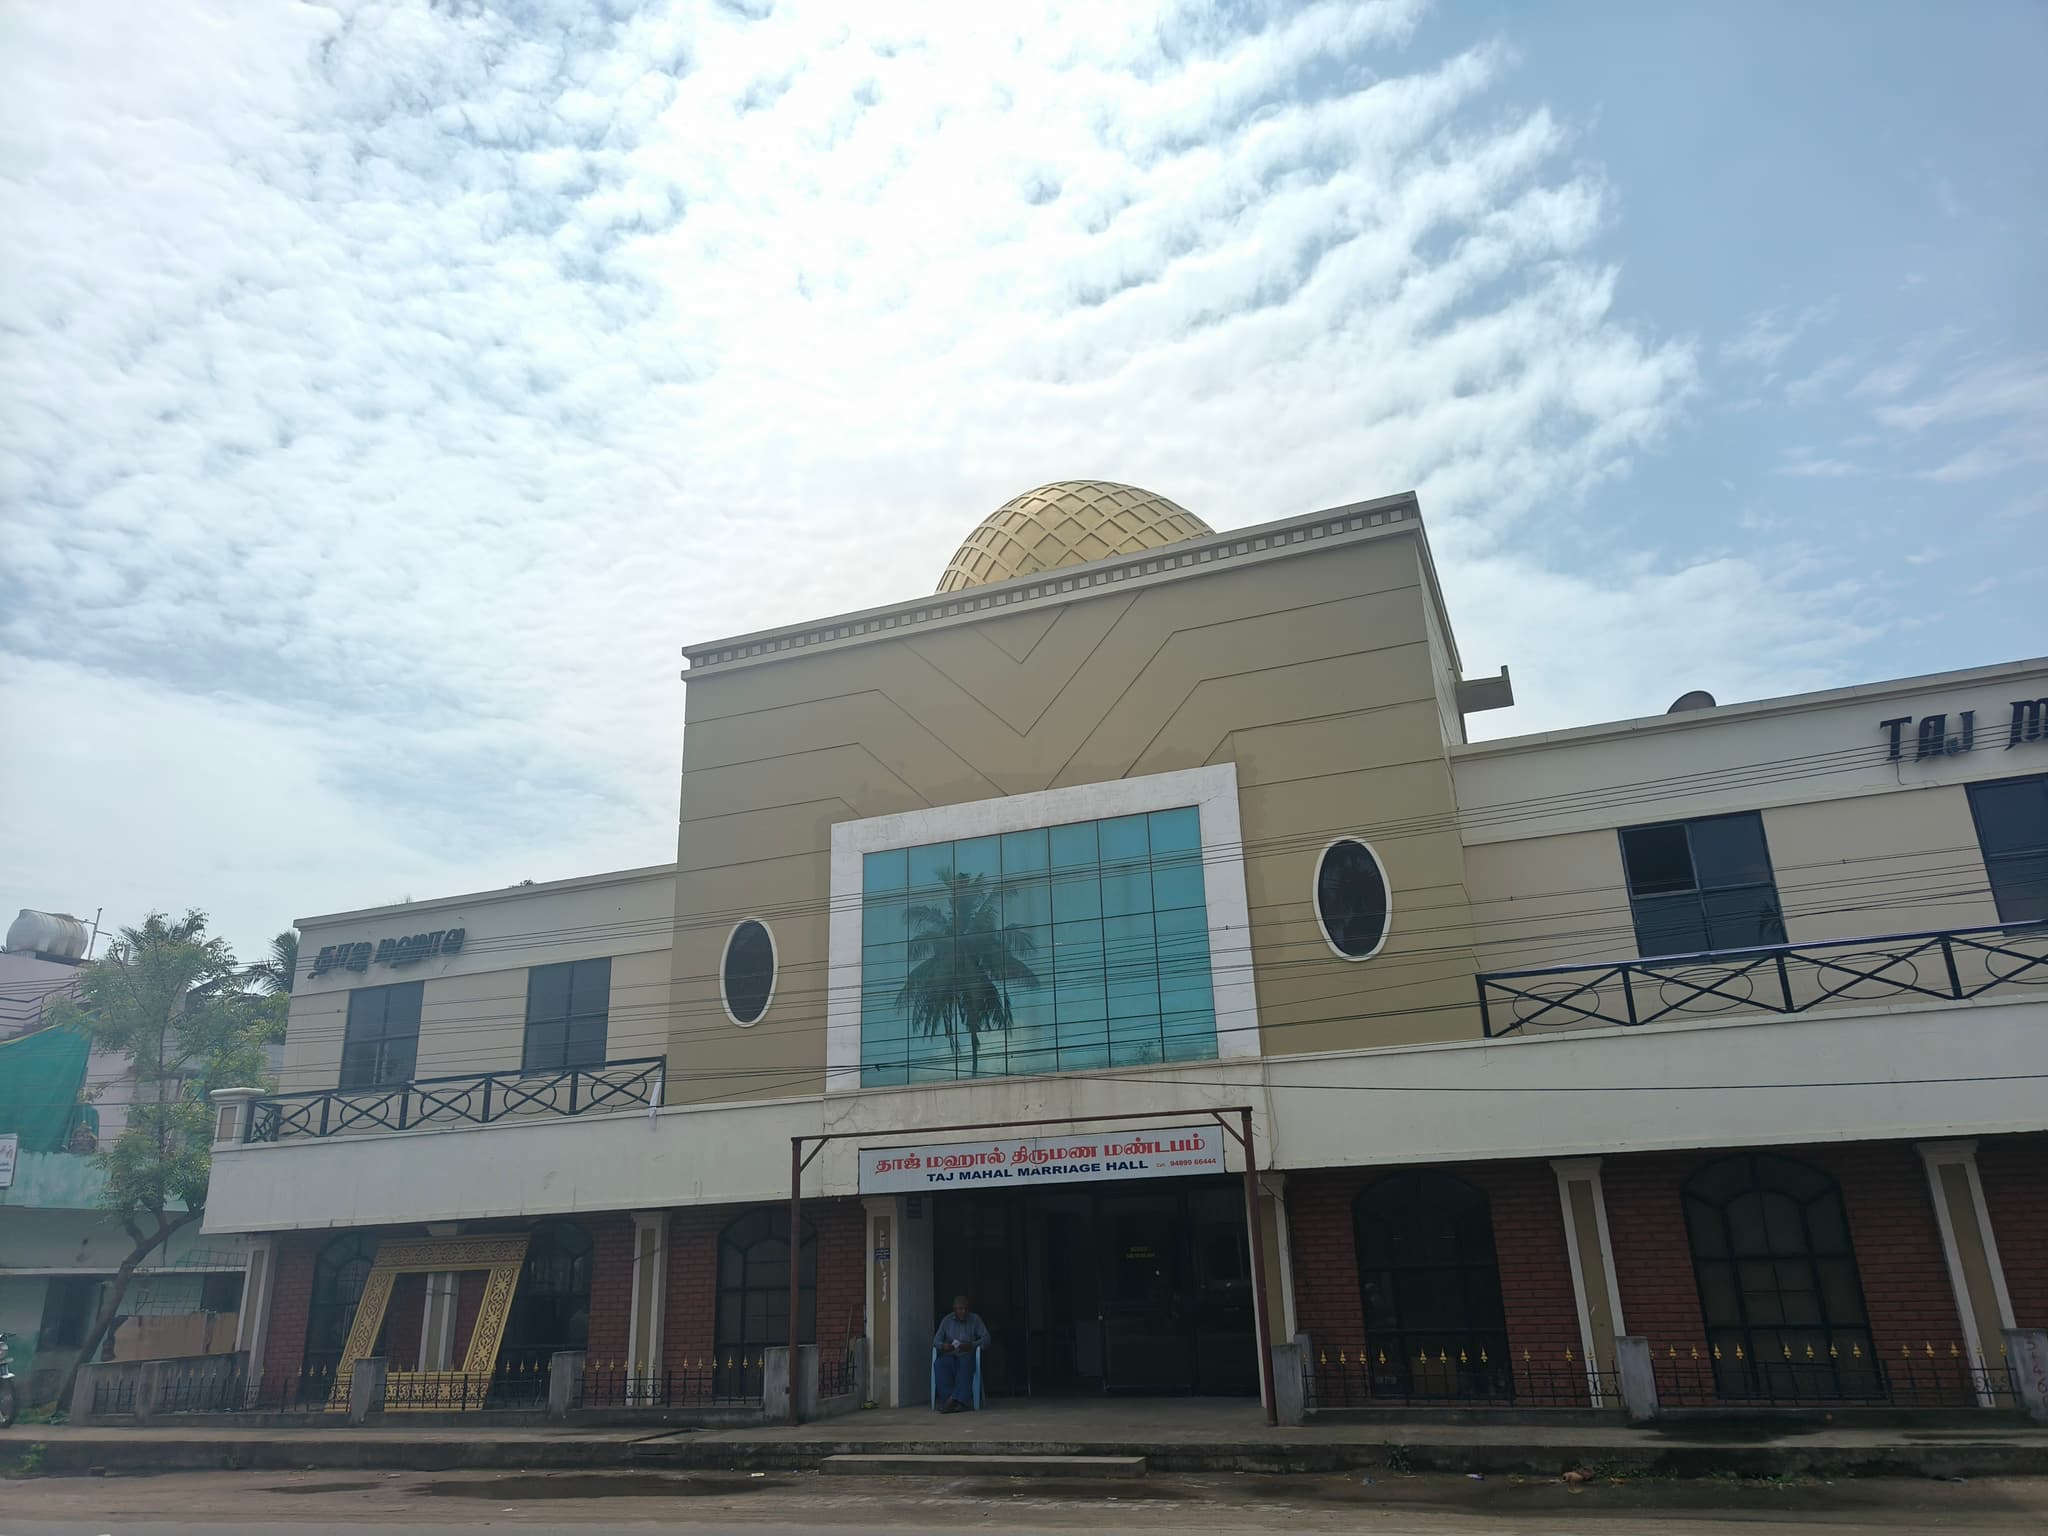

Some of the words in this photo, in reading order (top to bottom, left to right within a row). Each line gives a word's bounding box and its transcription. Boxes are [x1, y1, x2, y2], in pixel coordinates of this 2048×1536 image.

[1880, 710, 1976, 762] TAJ
[874, 1152, 921, 1175] தாஜ்
[926, 1146, 1006, 1171] மஹால்
[1010, 1145, 1098, 1167] திருமண
[1104, 1133, 1206, 1157] மண்டபம்
[926, 1172, 955, 1182] TAJ
[959, 1168, 1013, 1181] MAHAL
[1017, 1162, 1101, 1177] MARRIAGE
[1106, 1160, 1149, 1171] HALL
